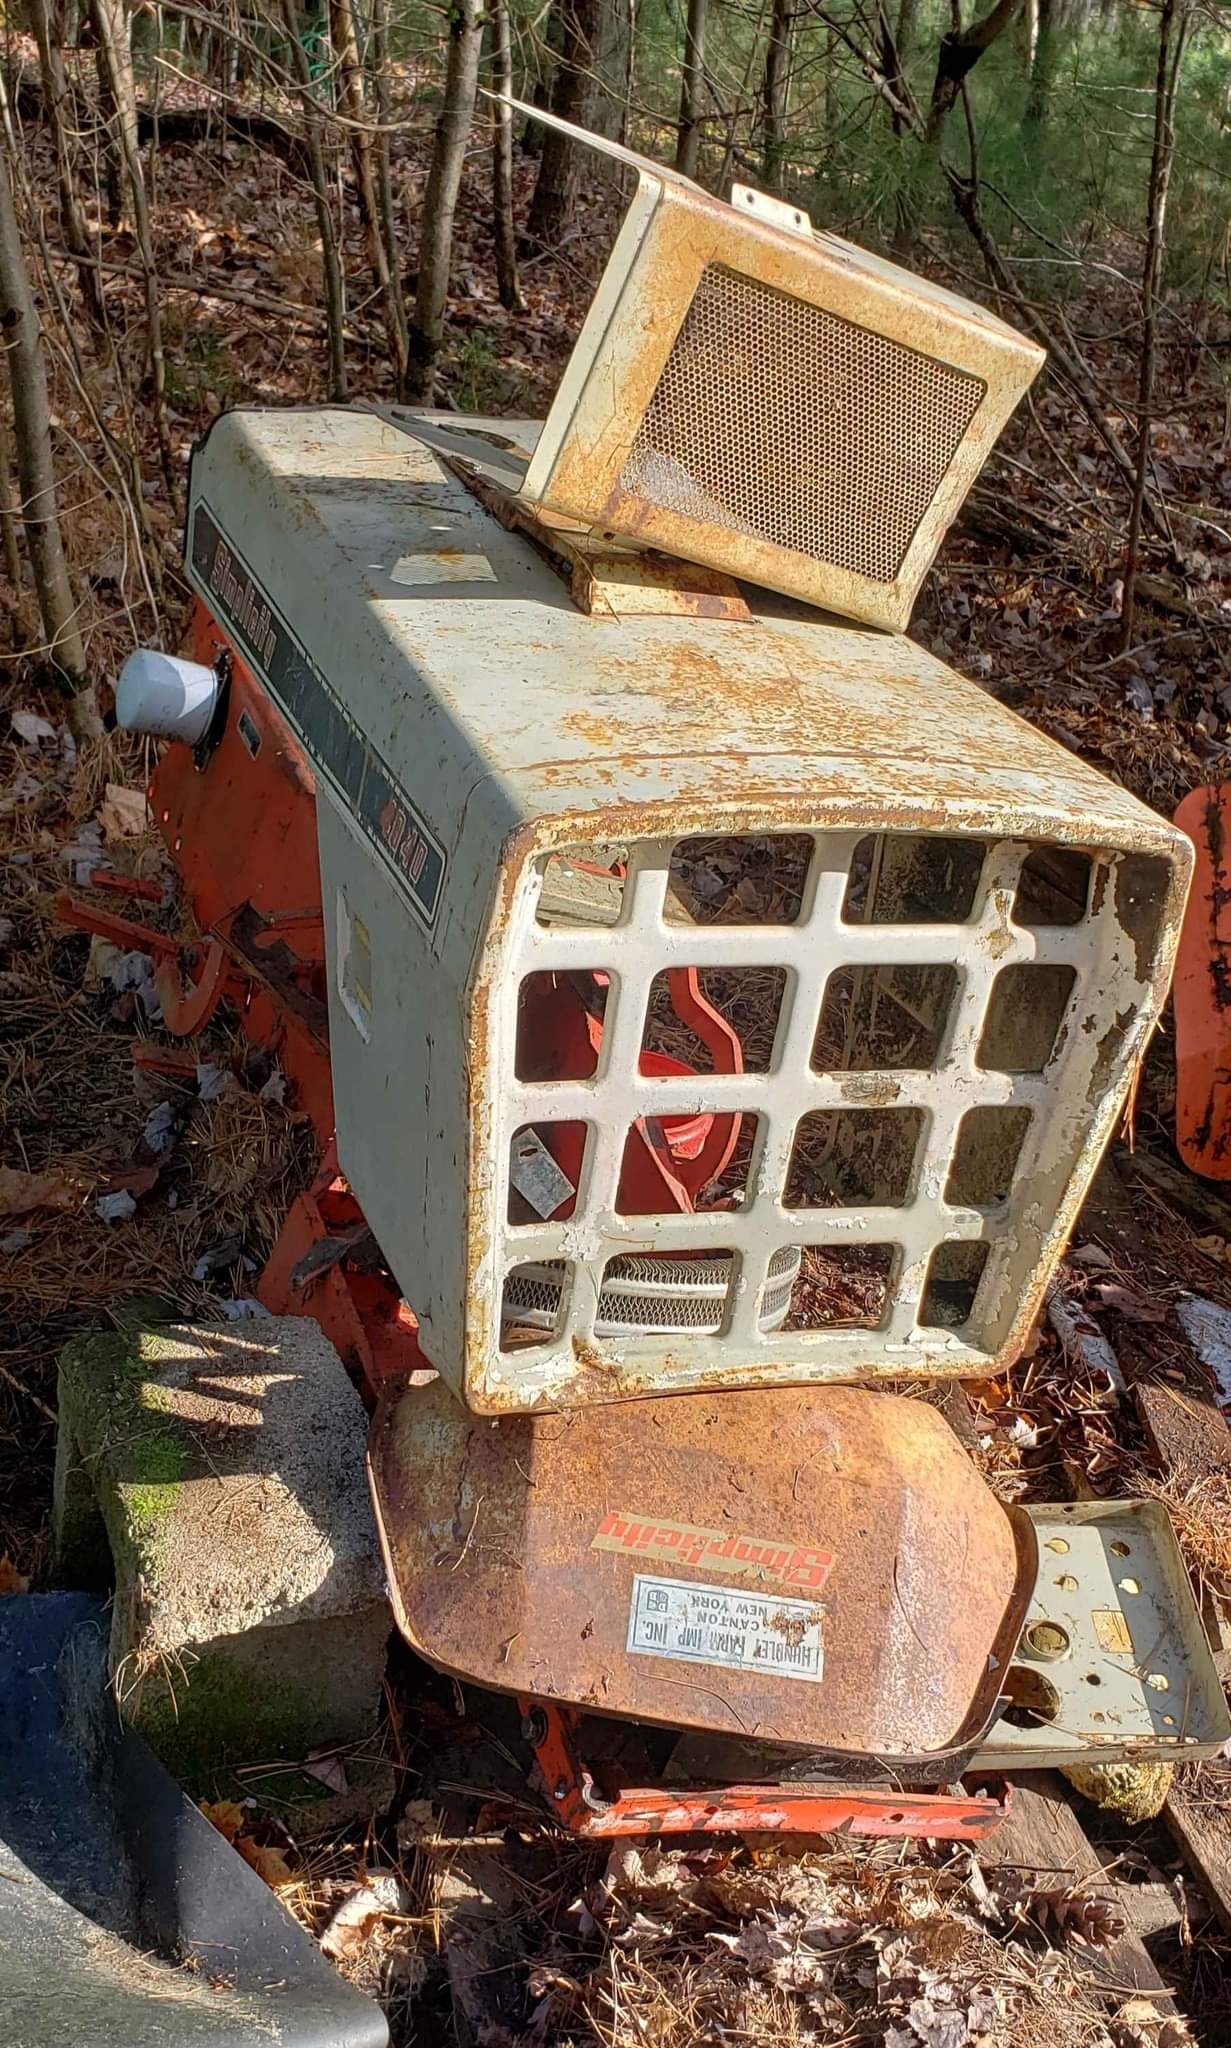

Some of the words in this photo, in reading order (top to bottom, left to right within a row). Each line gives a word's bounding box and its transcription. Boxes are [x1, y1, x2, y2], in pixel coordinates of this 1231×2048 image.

[209, 540, 278, 672] Simplicity
[600, 1512, 833, 1587] Simplicity
[697, 1611, 760, 1632] CANTON
[735, 1602, 768, 1617] NEW
[642, 1620, 668, 1645] INC.
